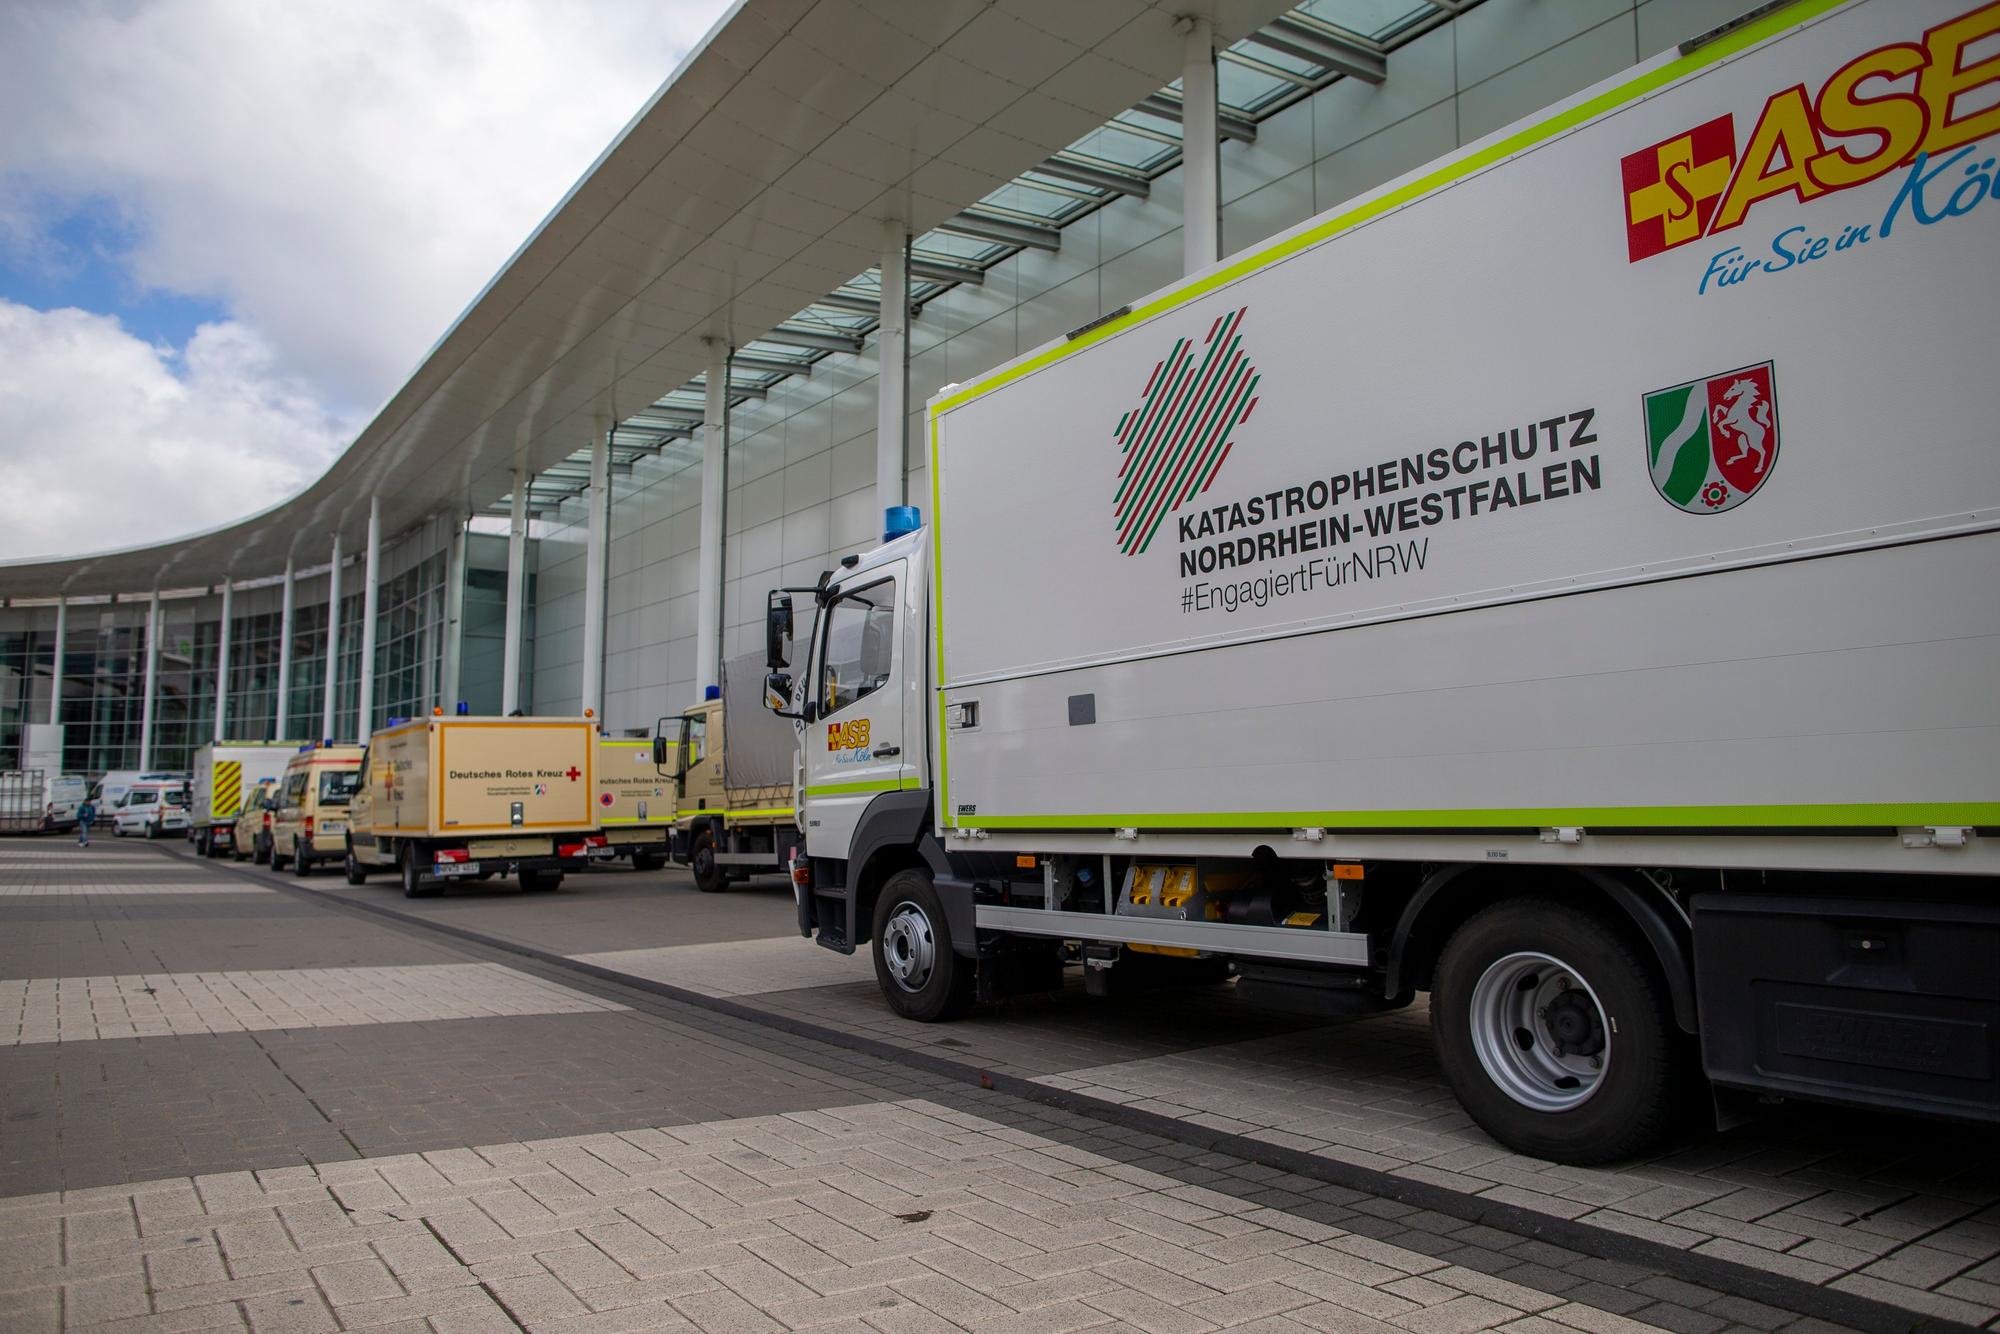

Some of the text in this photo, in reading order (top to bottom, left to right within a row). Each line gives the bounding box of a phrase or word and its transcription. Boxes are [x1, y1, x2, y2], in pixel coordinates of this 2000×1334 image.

[1699, 246, 1760, 295] Für
[1763, 227, 1828, 272] Sie
[1835, 225, 1871, 251] in
[1179, 408, 1598, 542] KATASTROPHENSCHUTZ
[1180, 455, 1601, 579] NORDRHEIN-WESTFALEN
[1181, 537, 1429, 613] #EngagiertFürNRW
[838, 719, 870, 750] ASB
[449, 769, 563, 780] Deutsches Rotes Kreuz
